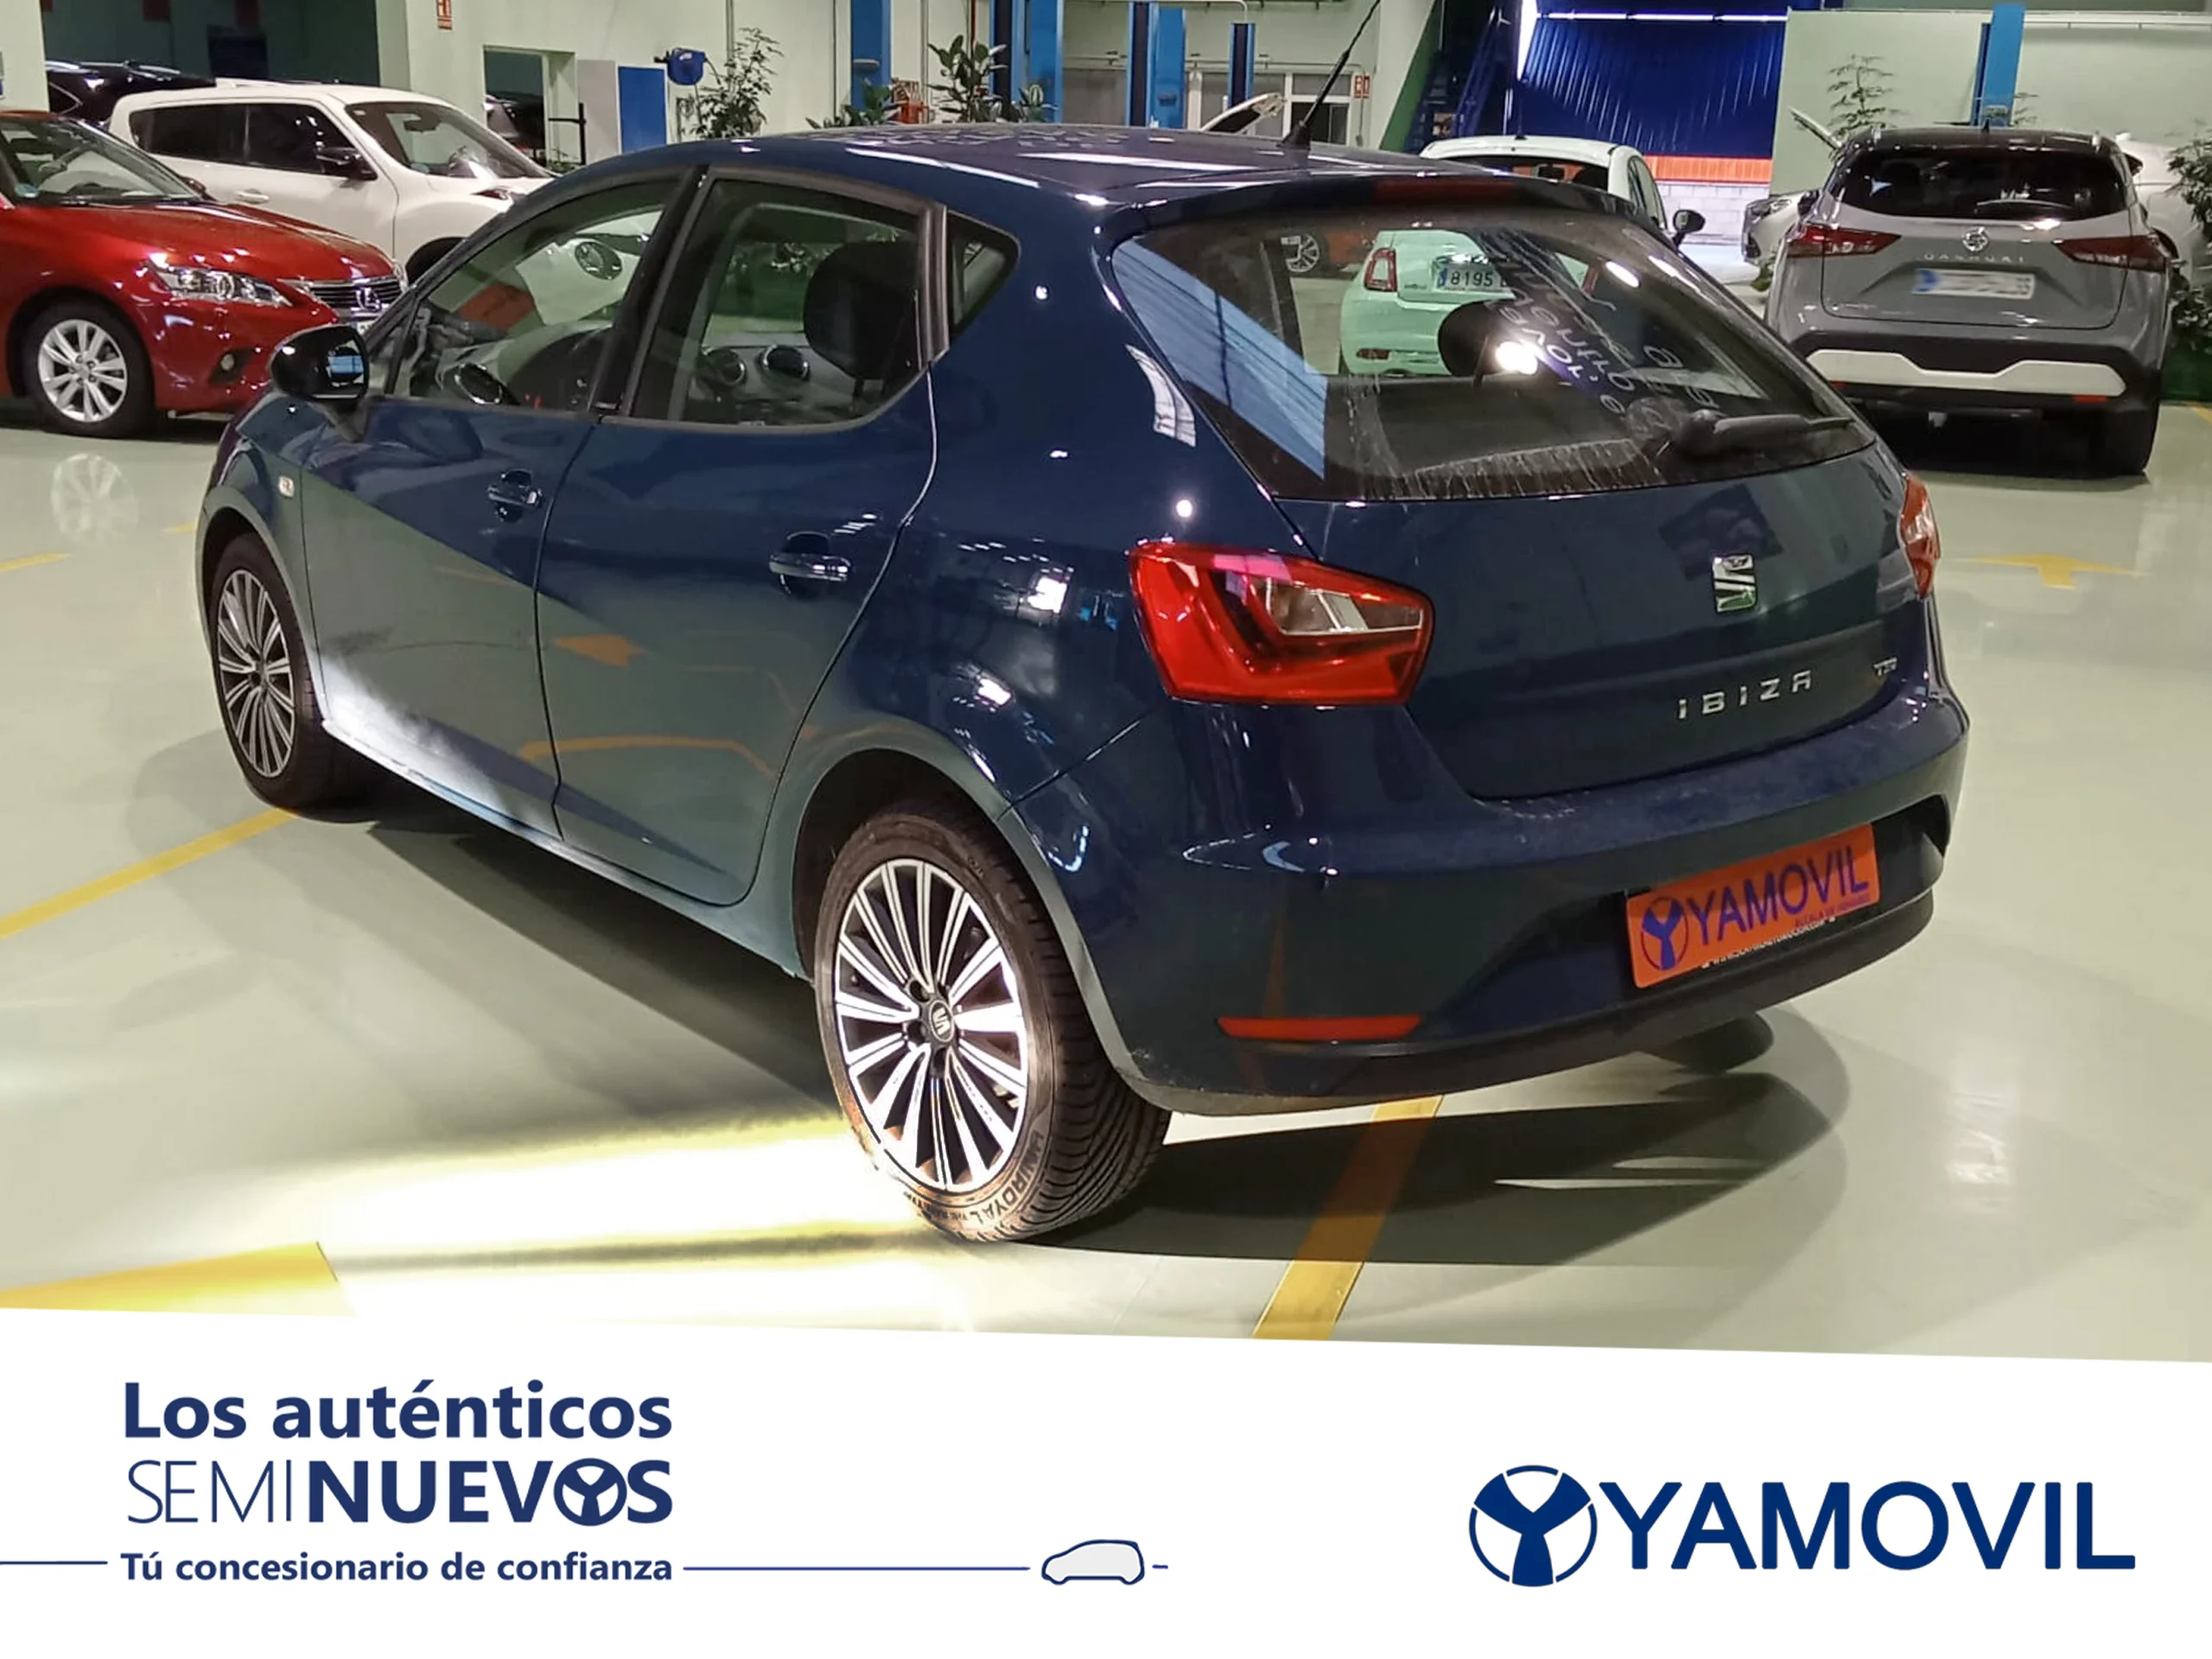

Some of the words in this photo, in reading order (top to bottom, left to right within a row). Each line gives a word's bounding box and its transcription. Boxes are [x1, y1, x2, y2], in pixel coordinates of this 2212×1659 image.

[1450, 270, 1494, 288] 8195
[1676, 670, 1812, 720] IBIZA
[1686, 845, 1870, 945] YAMOVIL
